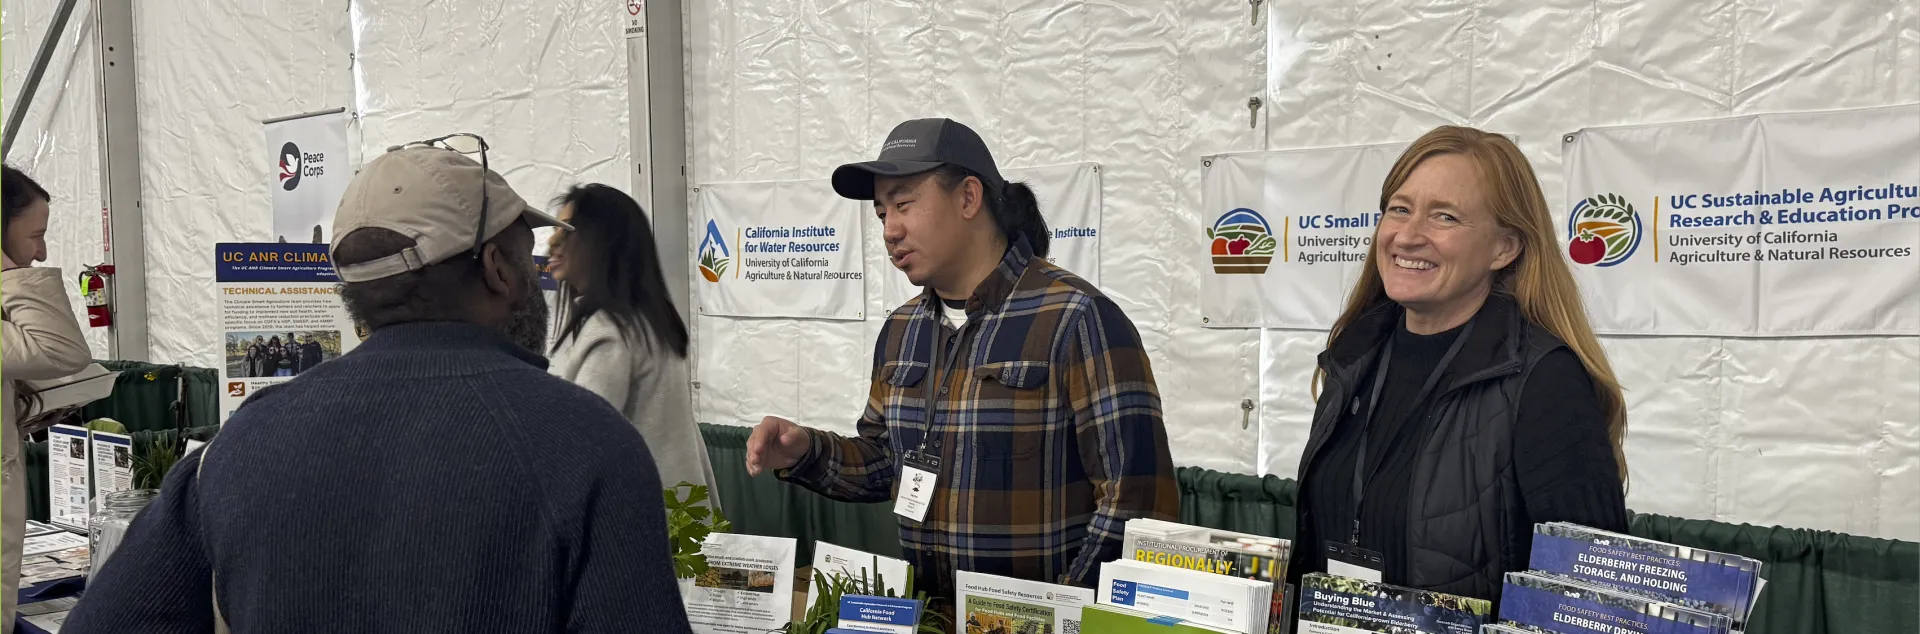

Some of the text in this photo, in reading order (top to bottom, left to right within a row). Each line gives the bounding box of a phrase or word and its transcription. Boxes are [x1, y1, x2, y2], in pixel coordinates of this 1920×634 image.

[303, 152, 324, 164] Peace
[303, 165, 324, 178] Corps
[1670, 183, 1920, 210] UC Sustainable Agricultu
[1298, 215, 1322, 229] UC
[1324, 212, 1369, 228] Small
[1669, 210, 1755, 228] Research
[1759, 210, 1773, 224] &
[1777, 206, 1881, 224] Education
[745, 226, 836, 238] California Institute
[1055, 226, 1096, 238] Institute
[1669, 230, 1838, 248] University of California
[744, 241, 840, 253] for Water Resources
[1298, 234, 1360, 249] University
[222, 252, 328, 262] UC ANR CLIMA
[745, 257, 829, 270] University of California
[1298, 250, 1366, 265] Agriculture
[1669, 246, 1911, 266] Agriculture & Natural Resources
[744, 270, 863, 282] Agriculture & Natural Resources
[222, 287, 278, 295] TECHNICAL
[1138, 540, 1178, 551] INSTITUTIONAL
[1178, 544, 1220, 556] PROCUREMENT
[1135, 549, 1237, 575] REGIONALLY-
[1588, 546, 1681, 567] FOOD SAFETY BEST PRACTICES:
[1578, 552, 1688, 581] ELDERBERRY FREEZING,
[1113, 581, 1127, 589] Food
[1572, 564, 1687, 593] STORAGE, AND HOLDING
[1002, 588, 1018, 597] Safety
[1018, 592, 1043, 600] Resources
[1112, 588, 1130, 596] Safety
[1314, 591, 1376, 608] Buying Blue
[972, 598, 987, 606] Guide
[993, 602, 1005, 610] Food
[1006, 604, 1022, 613] Safety
[1023, 606, 1053, 617] Certification
[1313, 601, 1352, 612] Understanding
[1363, 608, 1382, 616] Market
[1387, 613, 1415, 622] Assessing
[1014, 612, 1026, 620] Food
[1312, 607, 1337, 615] Potential
[1345, 612, 1390, 624] California-grown
[1390, 620, 1418, 629] Elderberry
[1553, 612, 1612, 633] ELDERBERRY
[1558, 603, 1649, 630] FOOD SAFETY BEST PRACTICES:
[1310, 623, 1340, 632] Introduction
